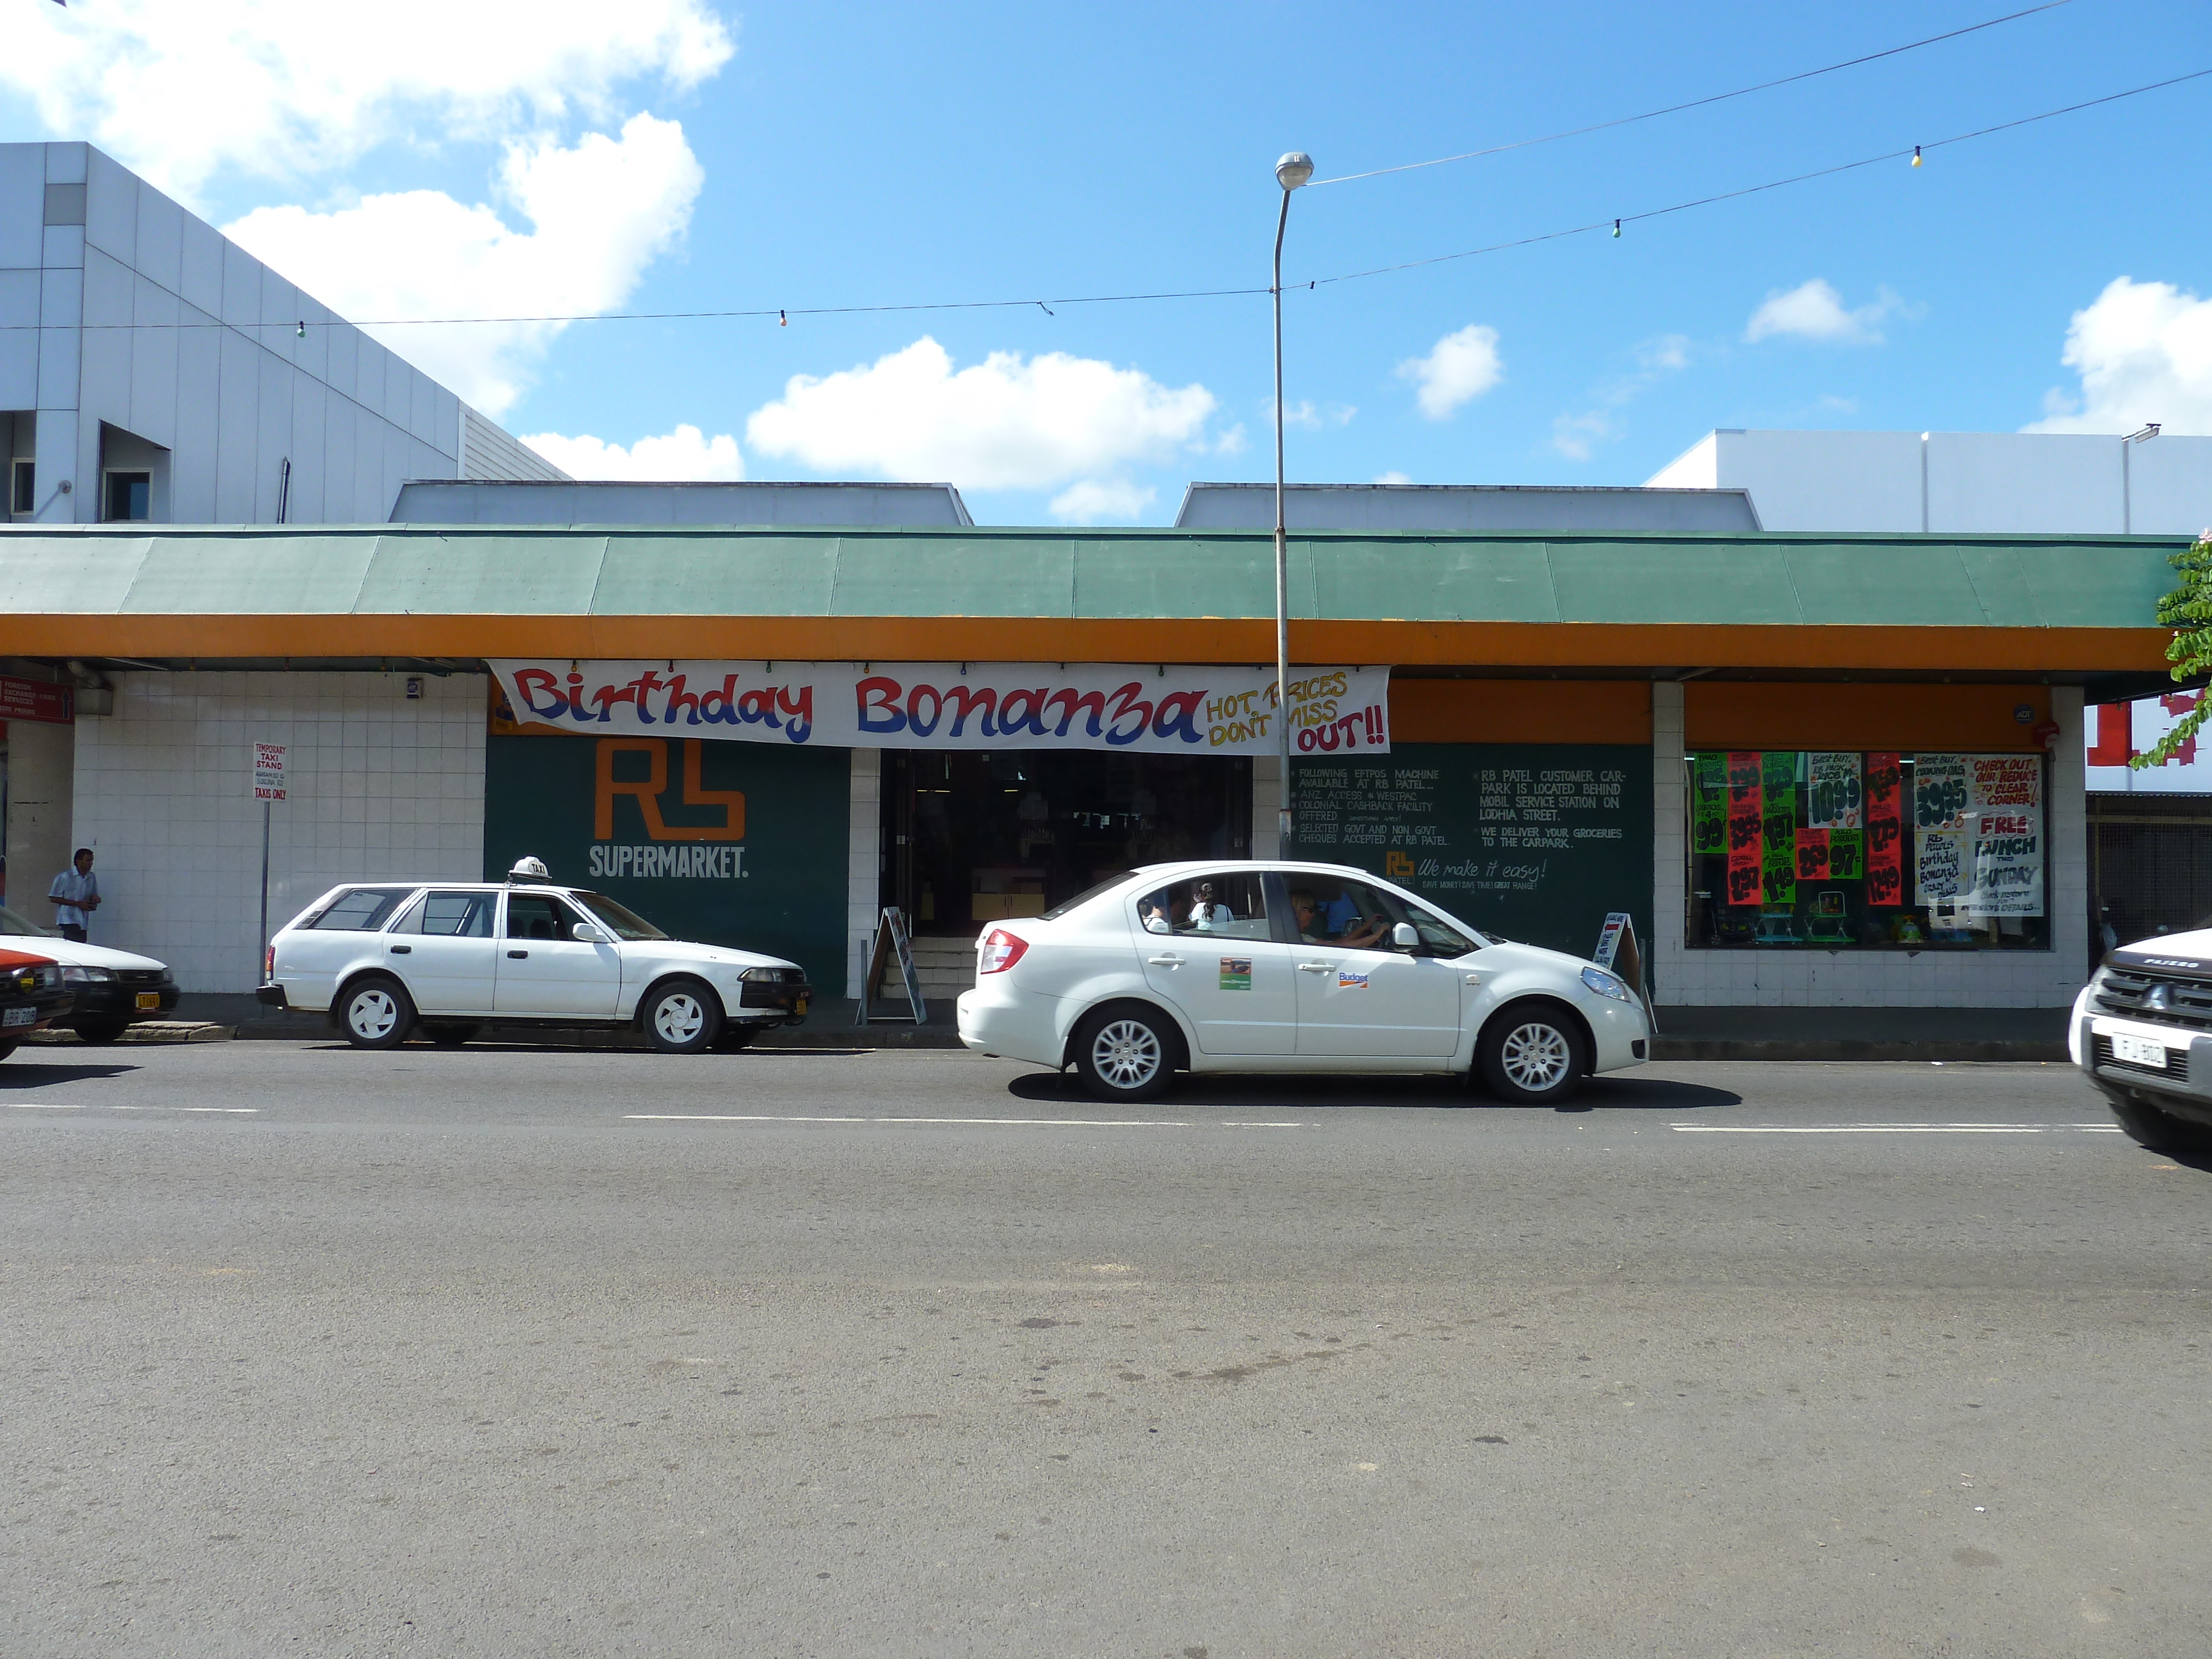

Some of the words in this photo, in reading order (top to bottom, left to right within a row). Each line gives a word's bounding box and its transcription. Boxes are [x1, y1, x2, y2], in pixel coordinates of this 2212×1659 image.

[4, 696, 34, 705] SERVICES
[1207, 691, 1258, 722] HOT
[513, 669, 812, 743] Birthday
[855, 676, 1209, 745] Bonanza
[1209, 711, 1271, 746] DON'T
[1297, 705, 1384, 752] OUT!!
[255, 743, 286, 754] TEMPORARY
[257, 761, 282, 769] STAND
[1974, 760, 2008, 771] CHECK
[2009, 759, 2032, 770] OUT
[1299, 769, 1347, 778] FOLLOWING
[1355, 769, 1386, 778] EFTPOS
[1395, 770, 1439, 779] MACHINE
[1481, 770, 1496, 781] RB
[1503, 770, 1532, 782] PATEL
[1540, 770, 1594, 782] CUSTOMER
[1975, 772, 1996, 782] OUR
[1999, 769, 2037, 782] REDUCE
[1299, 779, 1348, 788] AVAILABLE
[1357, 779, 1369, 789] AT
[1375, 780, 1389, 789] RB
[1481, 783, 1511, 794] PARK
[1517, 783, 1527, 794] IS
[1534, 783, 1575, 795] LOCATED
[1583, 784, 1620, 795] BEHIND
[1995, 782, 2028, 795] CLEAR
[255, 787, 271, 799] TAXIS
[273, 789, 286, 800] ONLY
[1301, 790, 1322, 799] ANZ
[1327, 791, 1362, 800] ACCESS
[1376, 791, 1417, 801] WESTPAC
[1300, 801, 1342, 810] COLONIAL
[1347, 801, 1394, 811] CASHBACK
[1397, 802, 1433, 811] FACILITY
[1480, 796, 1509, 807] MOBIL
[1515, 796, 1554, 808] SERVICE
[1558, 796, 1596, 808] STATION
[1604, 797, 1619, 808] ON
[1479, 808, 1517, 821] LODHIA
[1523, 809, 1560, 821] STREET.
[1300, 823, 1338, 833] SELECTED
[1344, 825, 1366, 834] GOVT
[1369, 825, 1387, 834] AND
[1392, 825, 1409, 834] NON
[1415, 826, 1437, 835] GOVT
[1980, 816, 2027, 834] FREE
[1481, 827, 1496, 836] WE
[1501, 827, 1539, 837] DELIVER
[1545, 828, 1569, 837] YOUR
[1573, 828, 1622, 838] GROCERIES
[1299, 833, 1337, 843] CHEQUES
[1343, 834, 1386, 844] ACCEPTED
[1391, 835, 1402, 844] AT
[1406, 836, 1417, 845] RB
[1482, 837, 1494, 847] TO
[1500, 837, 1517, 847] THE
[1975, 836, 2036, 857] LUNCH
[1920, 851, 1959, 870] Birthday
[531, 863, 545, 874] TAXI
[1418, 859, 1439, 877] We
[1443, 859, 1479, 877] make
[1486, 860, 1499, 877] it
[1502, 859, 1547, 882] easy!
[1974, 867, 2039, 890] SUNDAY
[1462, 881, 1475, 889] SAVE
[2144, 958, 2200, 968] PAJERO
[1339, 972, 1368, 984] Budget
